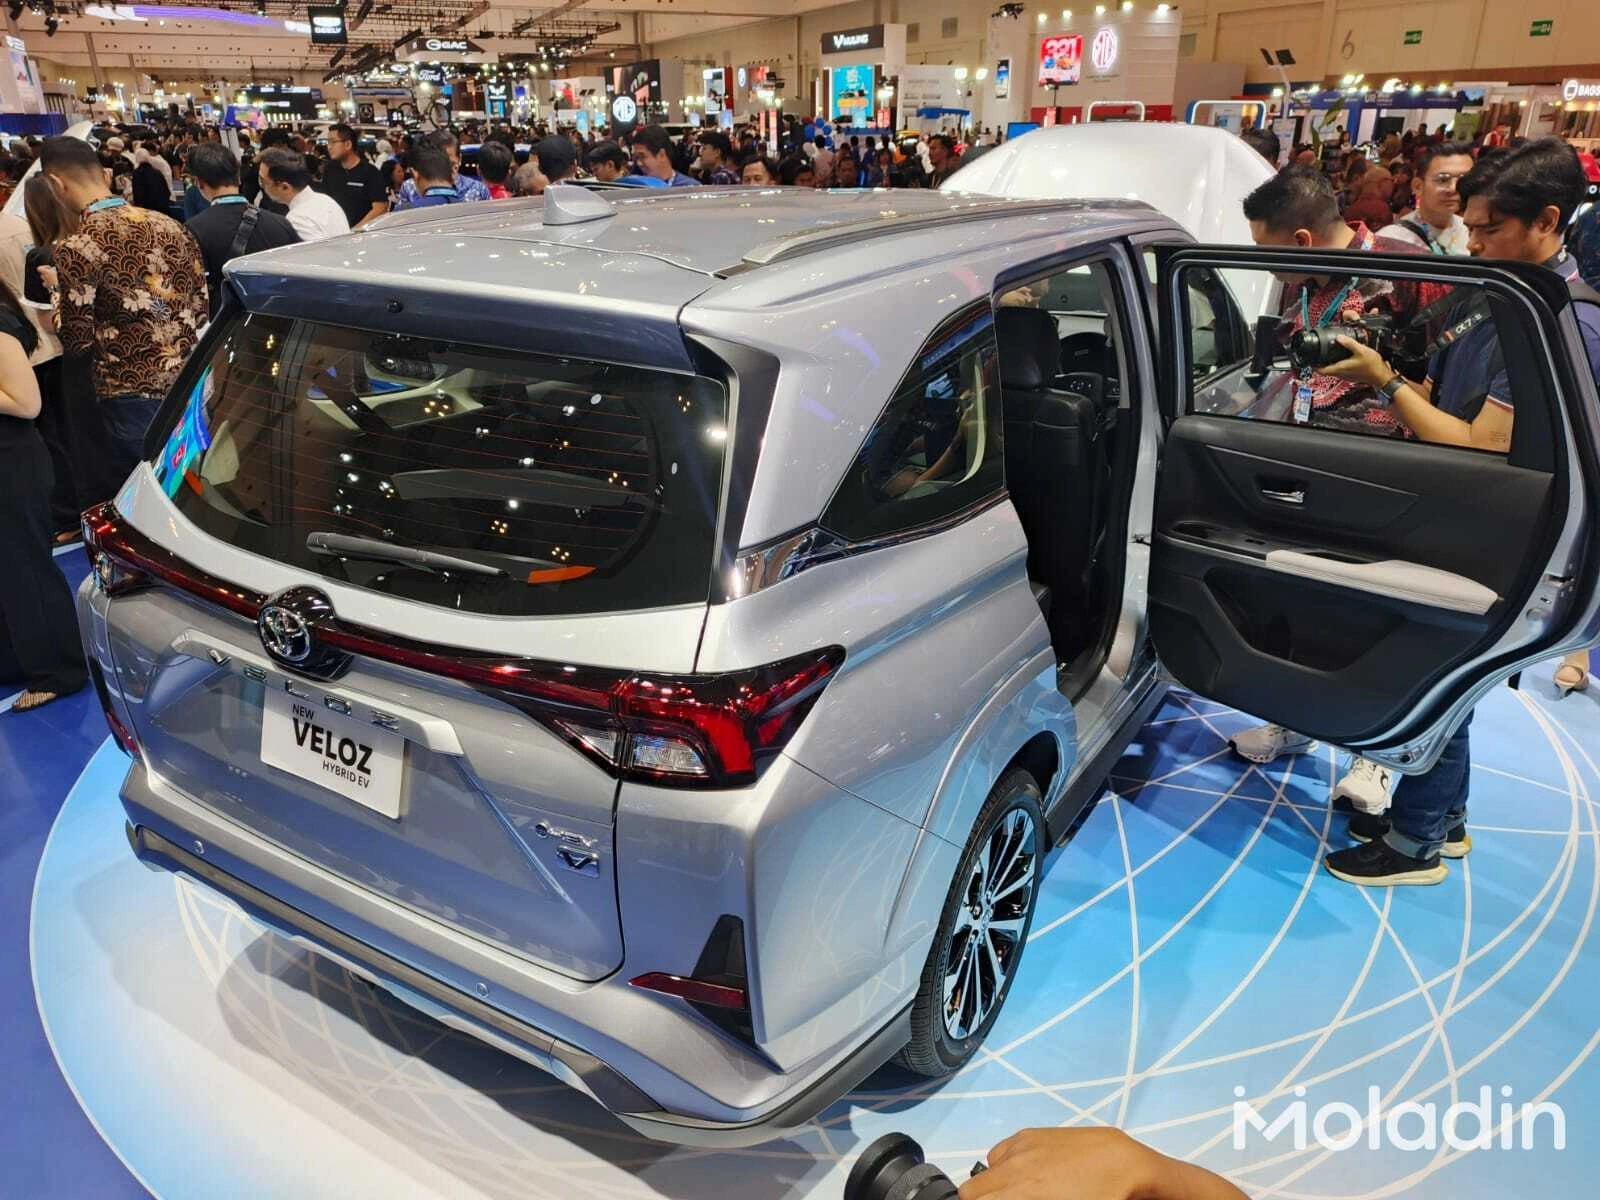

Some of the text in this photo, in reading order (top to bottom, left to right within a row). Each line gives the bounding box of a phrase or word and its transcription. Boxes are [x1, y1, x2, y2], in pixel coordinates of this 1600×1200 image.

[441, 41, 468, 50] GAC
[1342, 29, 1355, 60] 6
[418, 69, 441, 81] Ford
[292, 703, 315, 720] NEW
[292, 716, 373, 776] VELOZ
[322, 759, 370, 789] HYBRID EV
